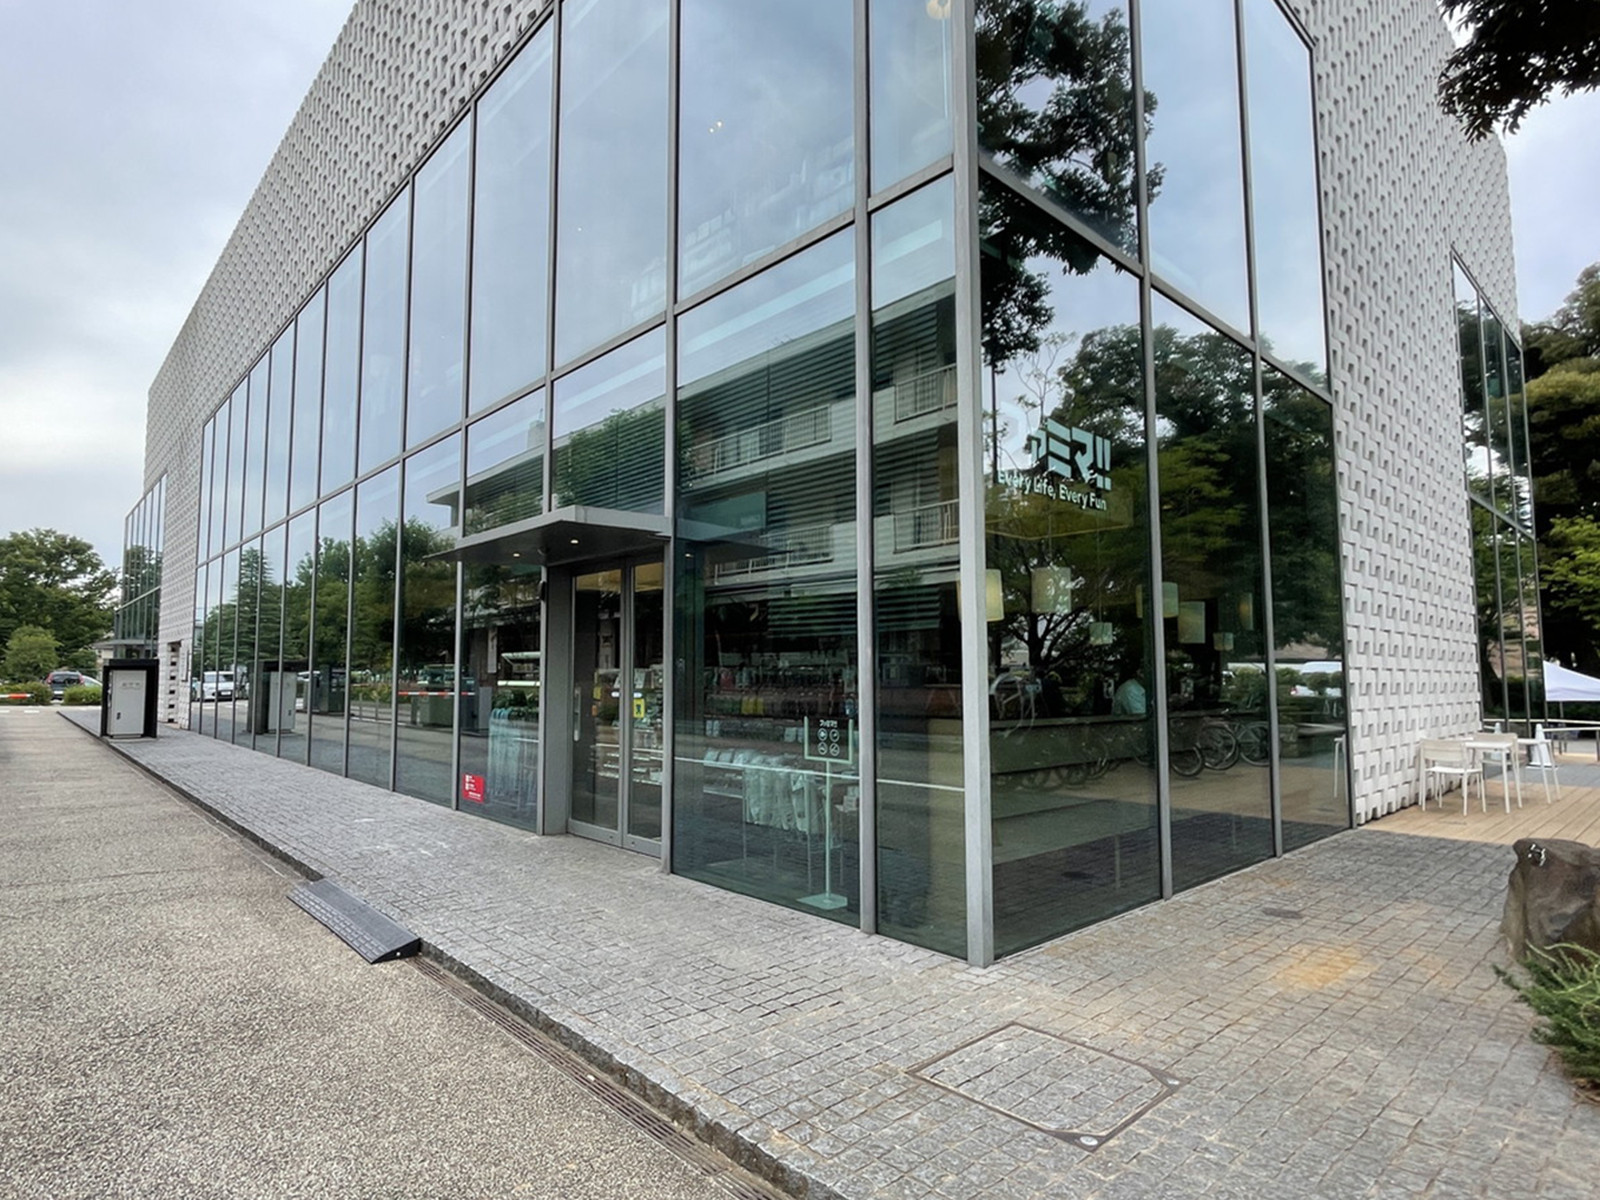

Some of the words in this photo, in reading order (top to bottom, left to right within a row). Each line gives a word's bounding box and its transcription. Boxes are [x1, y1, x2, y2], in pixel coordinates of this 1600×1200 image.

[998, 470, 1032, 494] Every
[1034, 477, 1056, 500] Life,
[1059, 484, 1088, 510] Every
[1090, 493, 1107, 511] Fun
